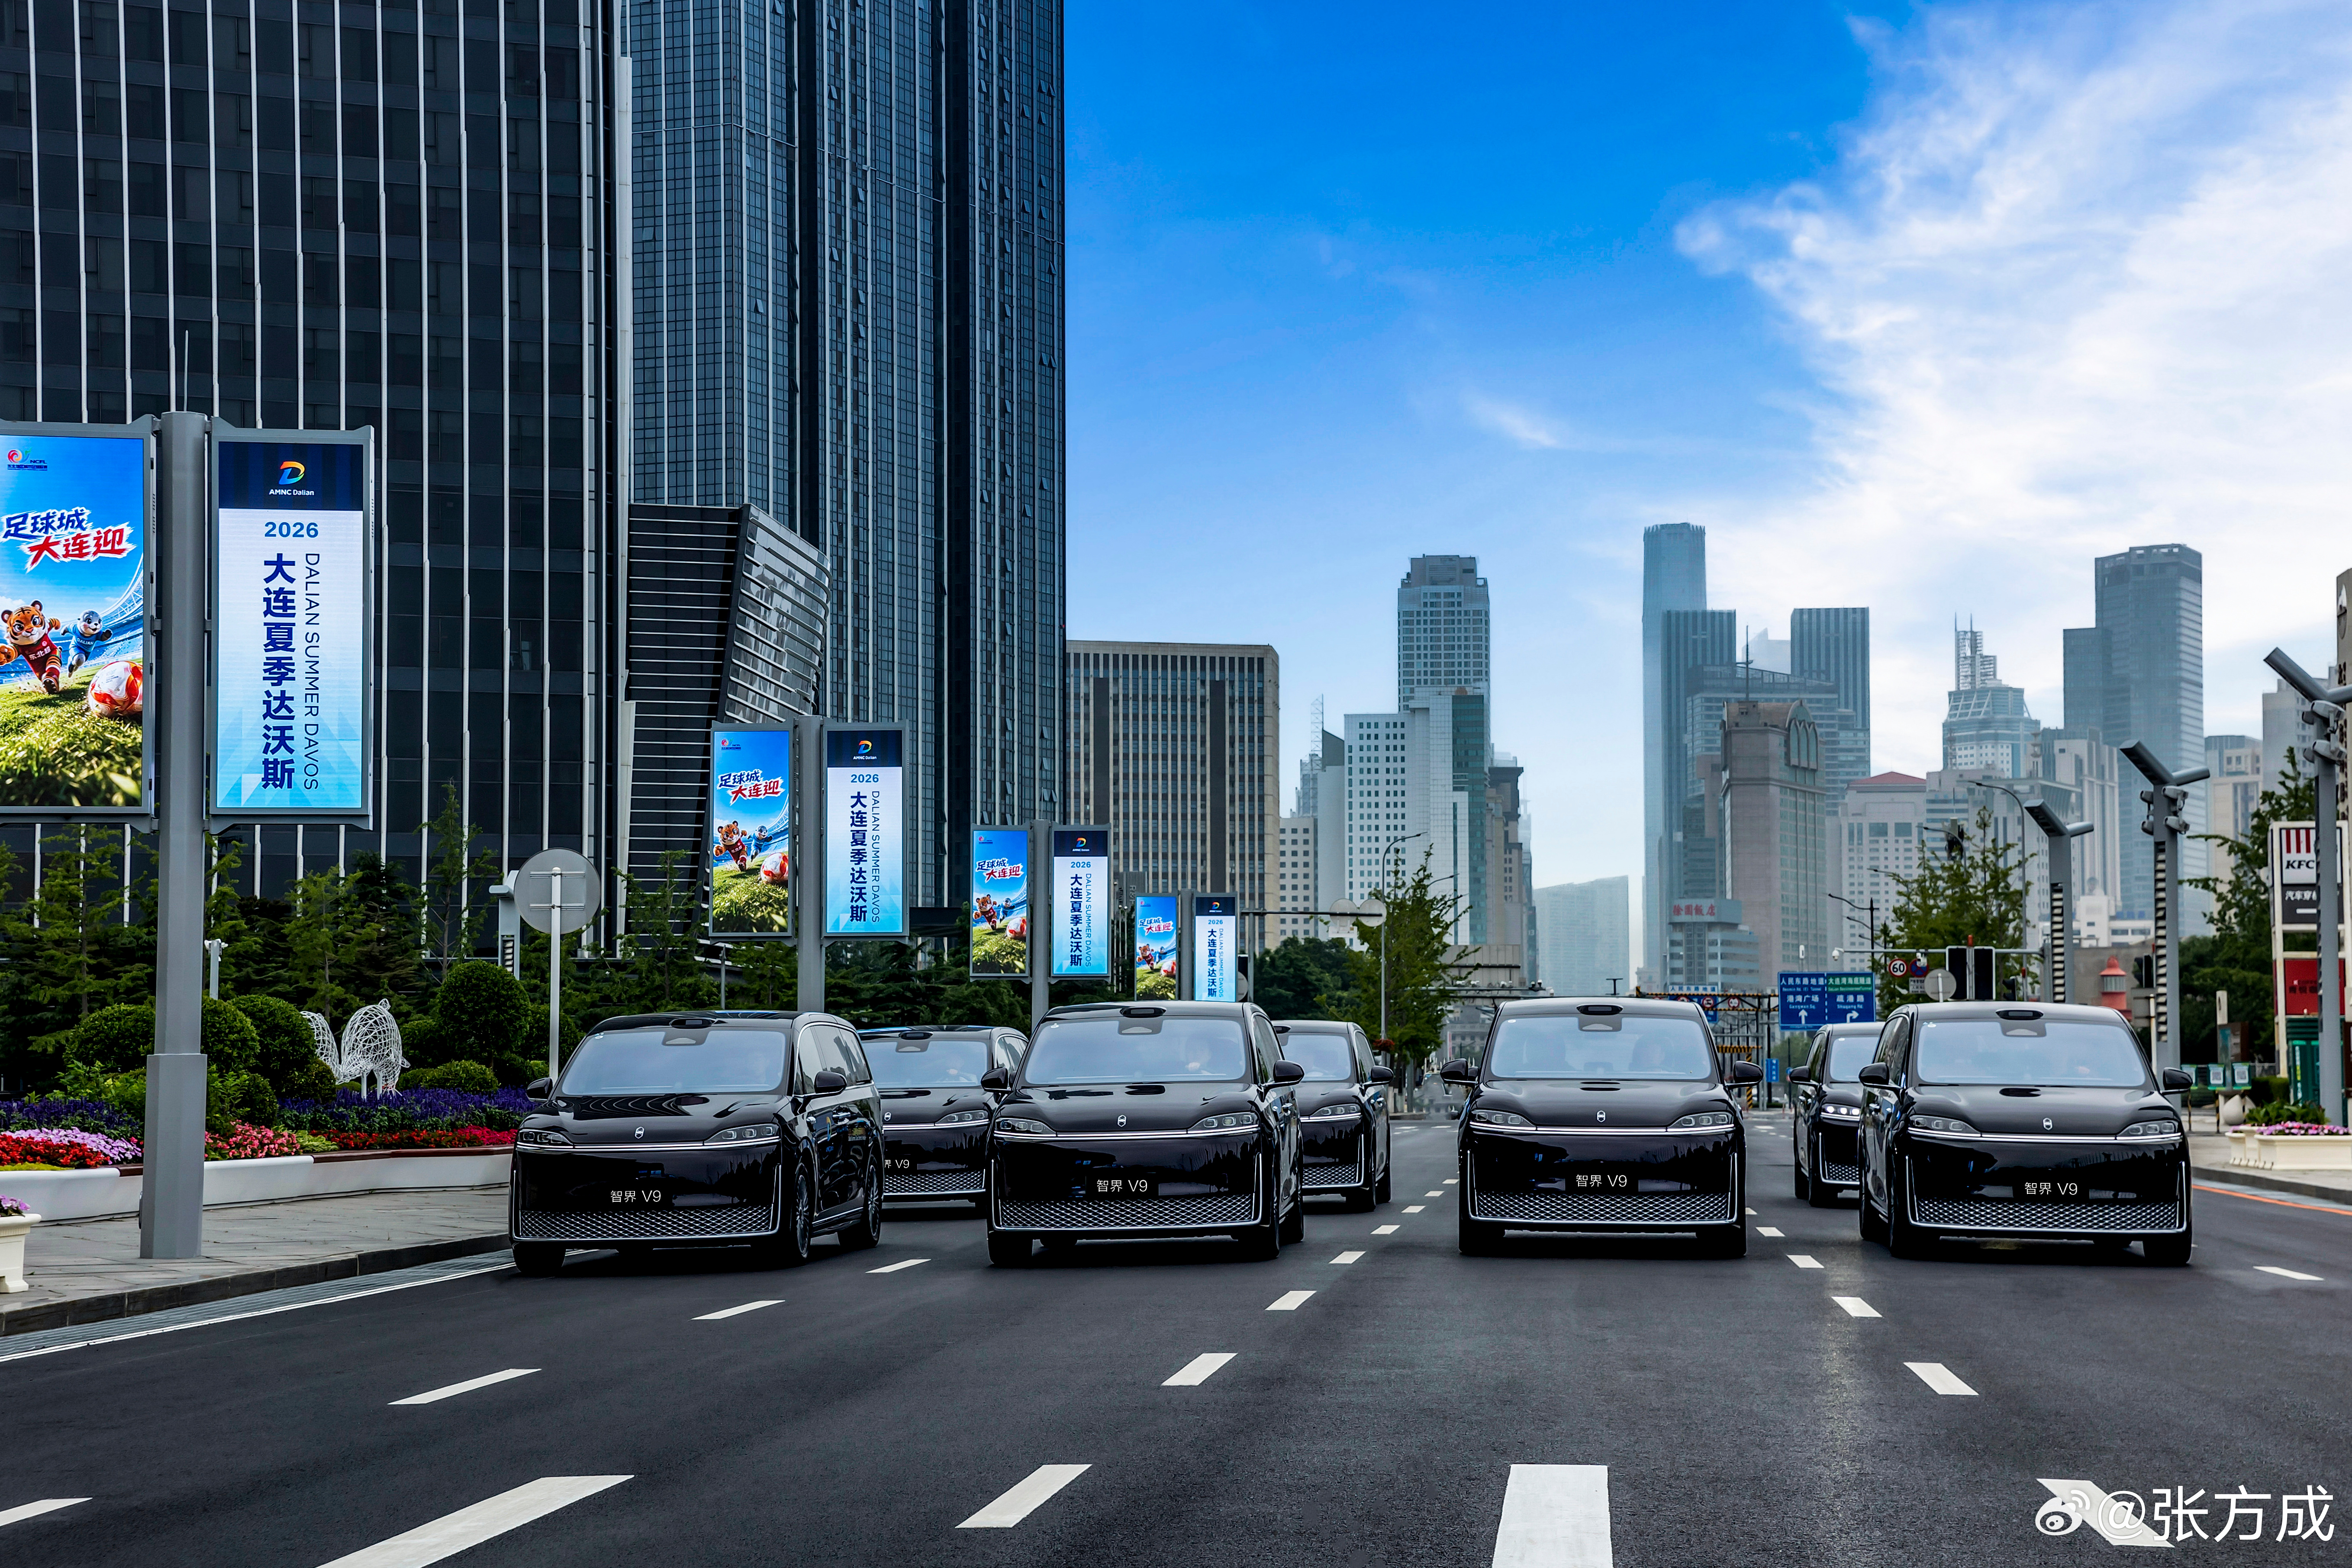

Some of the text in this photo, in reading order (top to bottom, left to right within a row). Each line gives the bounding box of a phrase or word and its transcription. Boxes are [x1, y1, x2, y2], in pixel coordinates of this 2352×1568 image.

[3, 509, 87, 539] 足球城
[264, 522, 319, 538] 2026
[28, 528, 129, 567] 大连迎
[262, 553, 296, 790] 大连夏季达沃斯
[303, 553, 320, 791] DALIAN SUMMER DAVOS
[718, 770, 760, 788] 足球城
[851, 774, 879, 783] 2026
[731, 780, 781, 802] 大连迎
[850, 791, 867, 922] 大连夏季达沃斯
[871, 791, 880, 923] DALIAN SUMMER DAVOS
[977, 858, 1007, 871] 足球城
[2285, 860, 2315, 869] KFC
[986, 866, 1021, 881] 大连迎
[1070, 874, 1083, 967] 大连夏季达沃斯
[1146, 923, 1172, 934] 大连迎
[1208, 928, 1217, 997] 大连夏季达沃斯
[1892, 963, 1905, 972] 60
[885, 1160, 909, 1168] 界 V9
[1097, 1180, 1147, 1191] 智界 V9
[1576, 1175, 1627, 1187] 智界 V9
[2025, 1182, 2077, 1195] 智界 V9
[611, 1191, 660, 1202] 智界 V9
